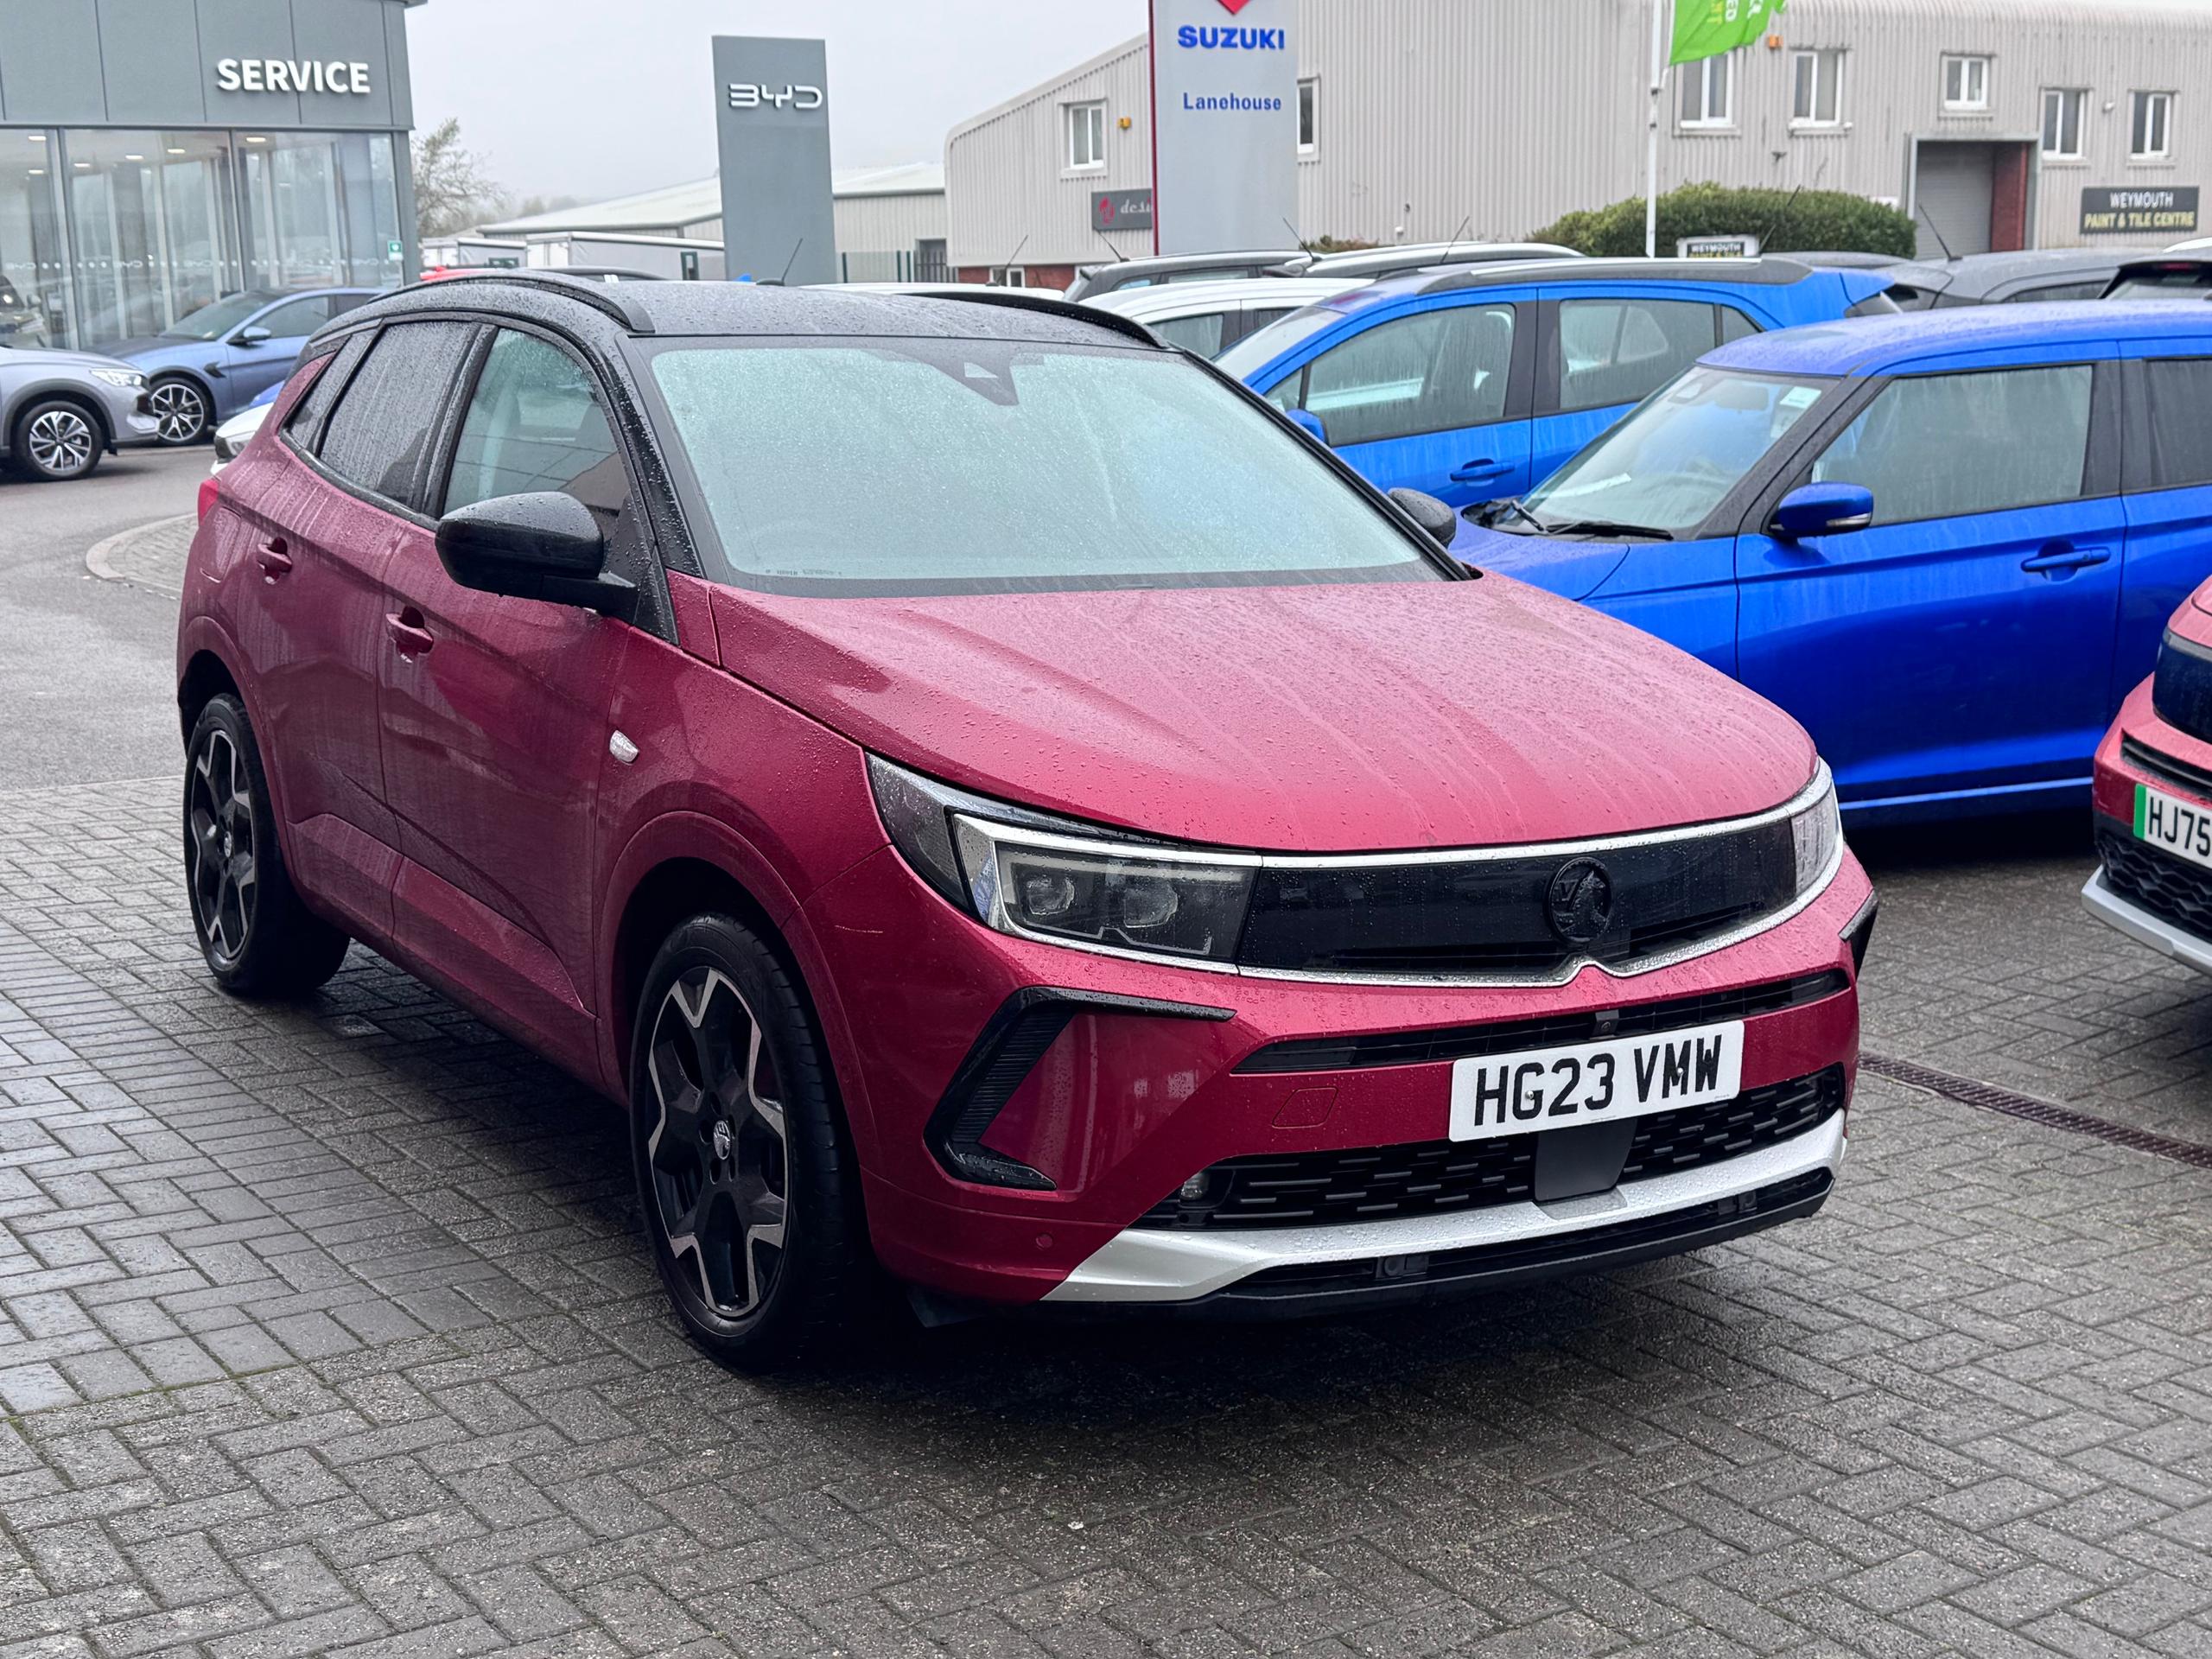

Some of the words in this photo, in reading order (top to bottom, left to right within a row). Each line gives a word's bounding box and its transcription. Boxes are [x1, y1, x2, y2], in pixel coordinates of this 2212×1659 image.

[1177, 24, 1286, 50] SUZUKI
[217, 57, 372, 94] SERVICE
[728, 83, 823, 109] BYD
[1182, 92, 1282, 111] Lanehouse
[2109, 190, 2175, 209] WEYMOUTH
[2083, 213, 2116, 230] PAINT
[2128, 212, 2152, 228] TILE
[2152, 211, 2196, 228] CENTRE
[2148, 796, 2212, 857] HJ75
[1474, 1052, 1616, 1127] HG23
[1634, 1034, 1723, 1103] VMW
